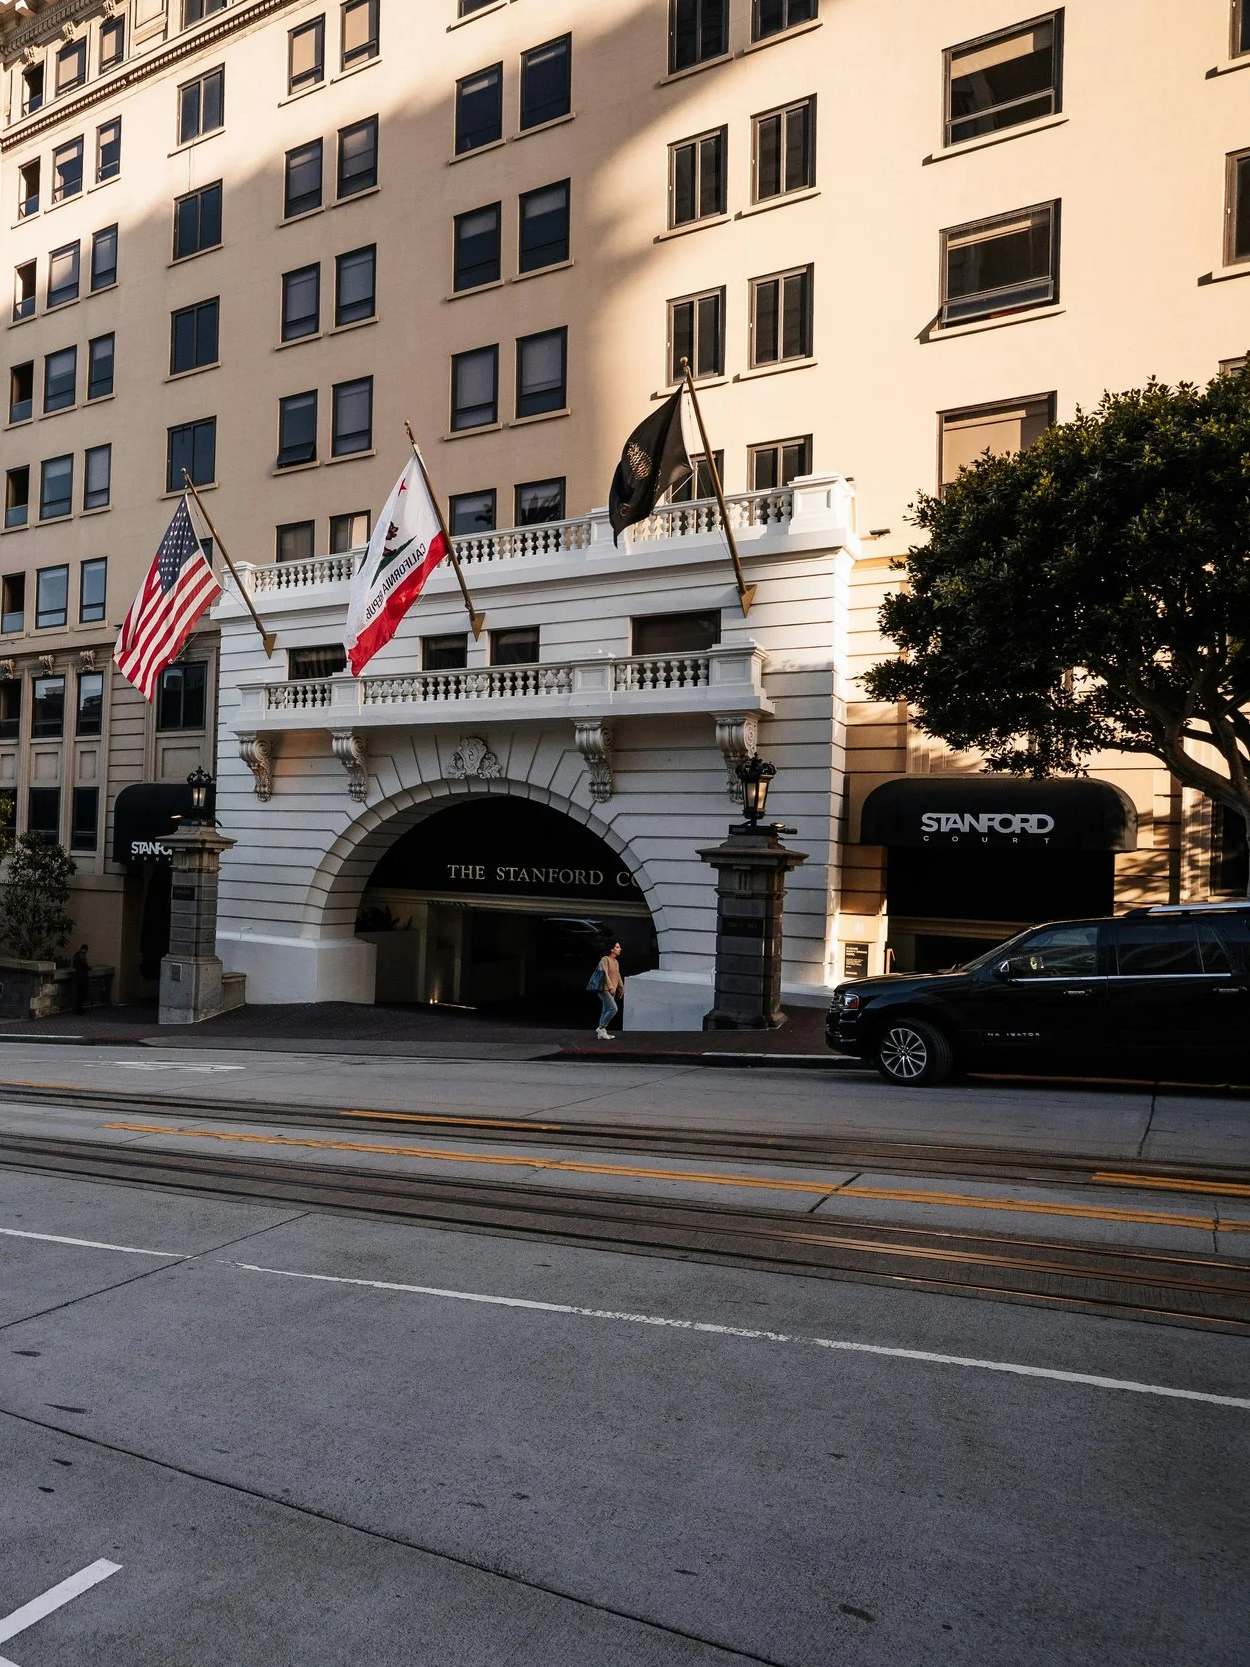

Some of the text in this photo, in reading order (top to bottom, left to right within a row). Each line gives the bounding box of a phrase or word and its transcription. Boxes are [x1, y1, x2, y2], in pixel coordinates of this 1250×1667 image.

[920, 812, 1055, 834] STANFORD
[131, 841, 172, 856] STANFO
[922, 835, 1050, 844] COURT
[447, 864, 486, 881] THE
[496, 866, 604, 886] STANFORD
